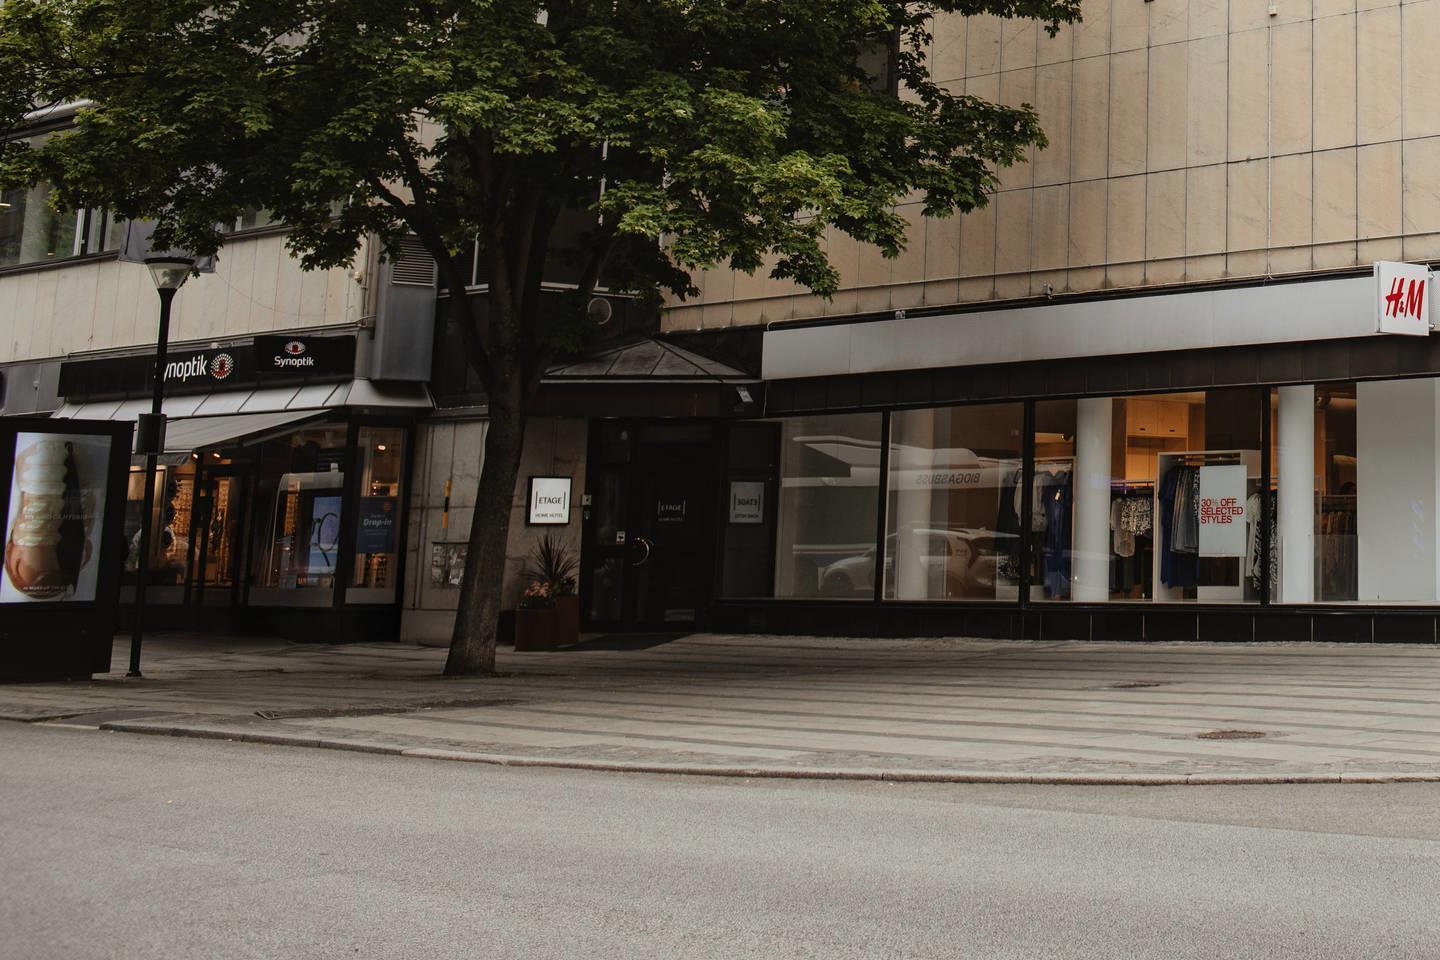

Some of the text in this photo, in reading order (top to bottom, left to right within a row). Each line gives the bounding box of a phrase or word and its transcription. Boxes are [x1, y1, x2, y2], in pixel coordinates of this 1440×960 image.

[1385, 276, 1425, 320] H&M
[274, 356, 314, 368] Synoptik
[539, 496, 562, 504] ETAGE
[1221, 498, 1237, 506] OFF
[1201, 506, 1243, 515] SELECTED
[1201, 515, 1232, 524] STYLES
